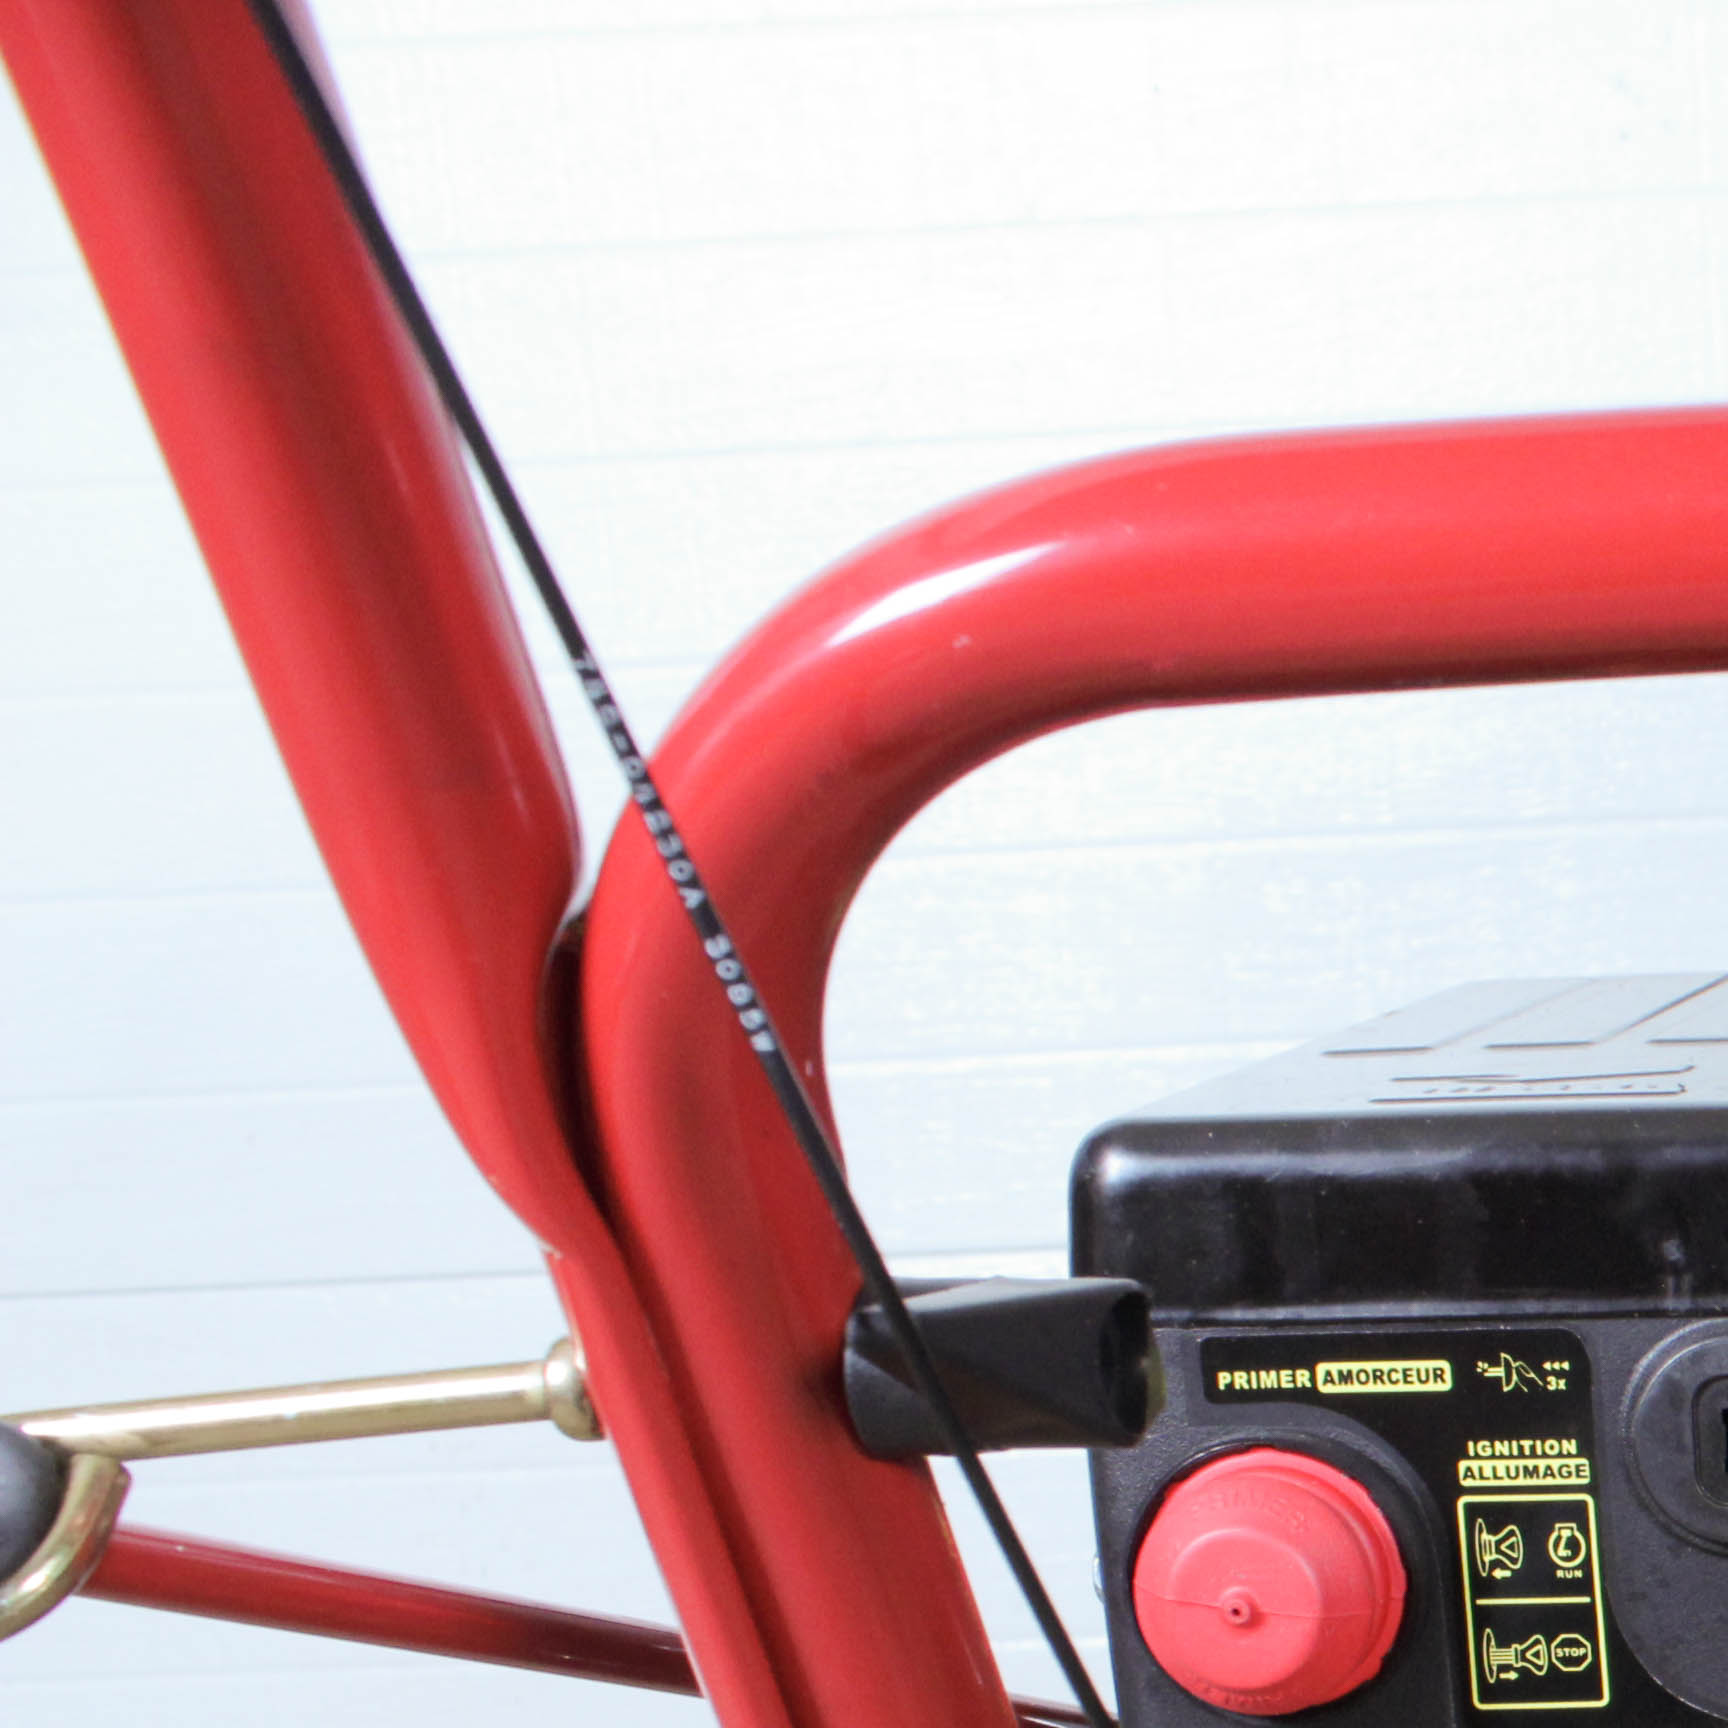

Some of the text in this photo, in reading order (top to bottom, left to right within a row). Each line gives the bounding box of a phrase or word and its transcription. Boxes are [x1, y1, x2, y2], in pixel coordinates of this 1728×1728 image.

[1217, 1369, 1312, 1391] PRIMER
[1321, 1366, 1447, 1387] AMORCEUR
[1546, 1375, 1567, 1391] 3x
[1467, 1438, 1578, 1457] IGNITION
[1462, 1463, 1589, 1481] ALLUMAGE
[1556, 1569, 1583, 1579] RUN
[1556, 1647, 1587, 1658] STOP
